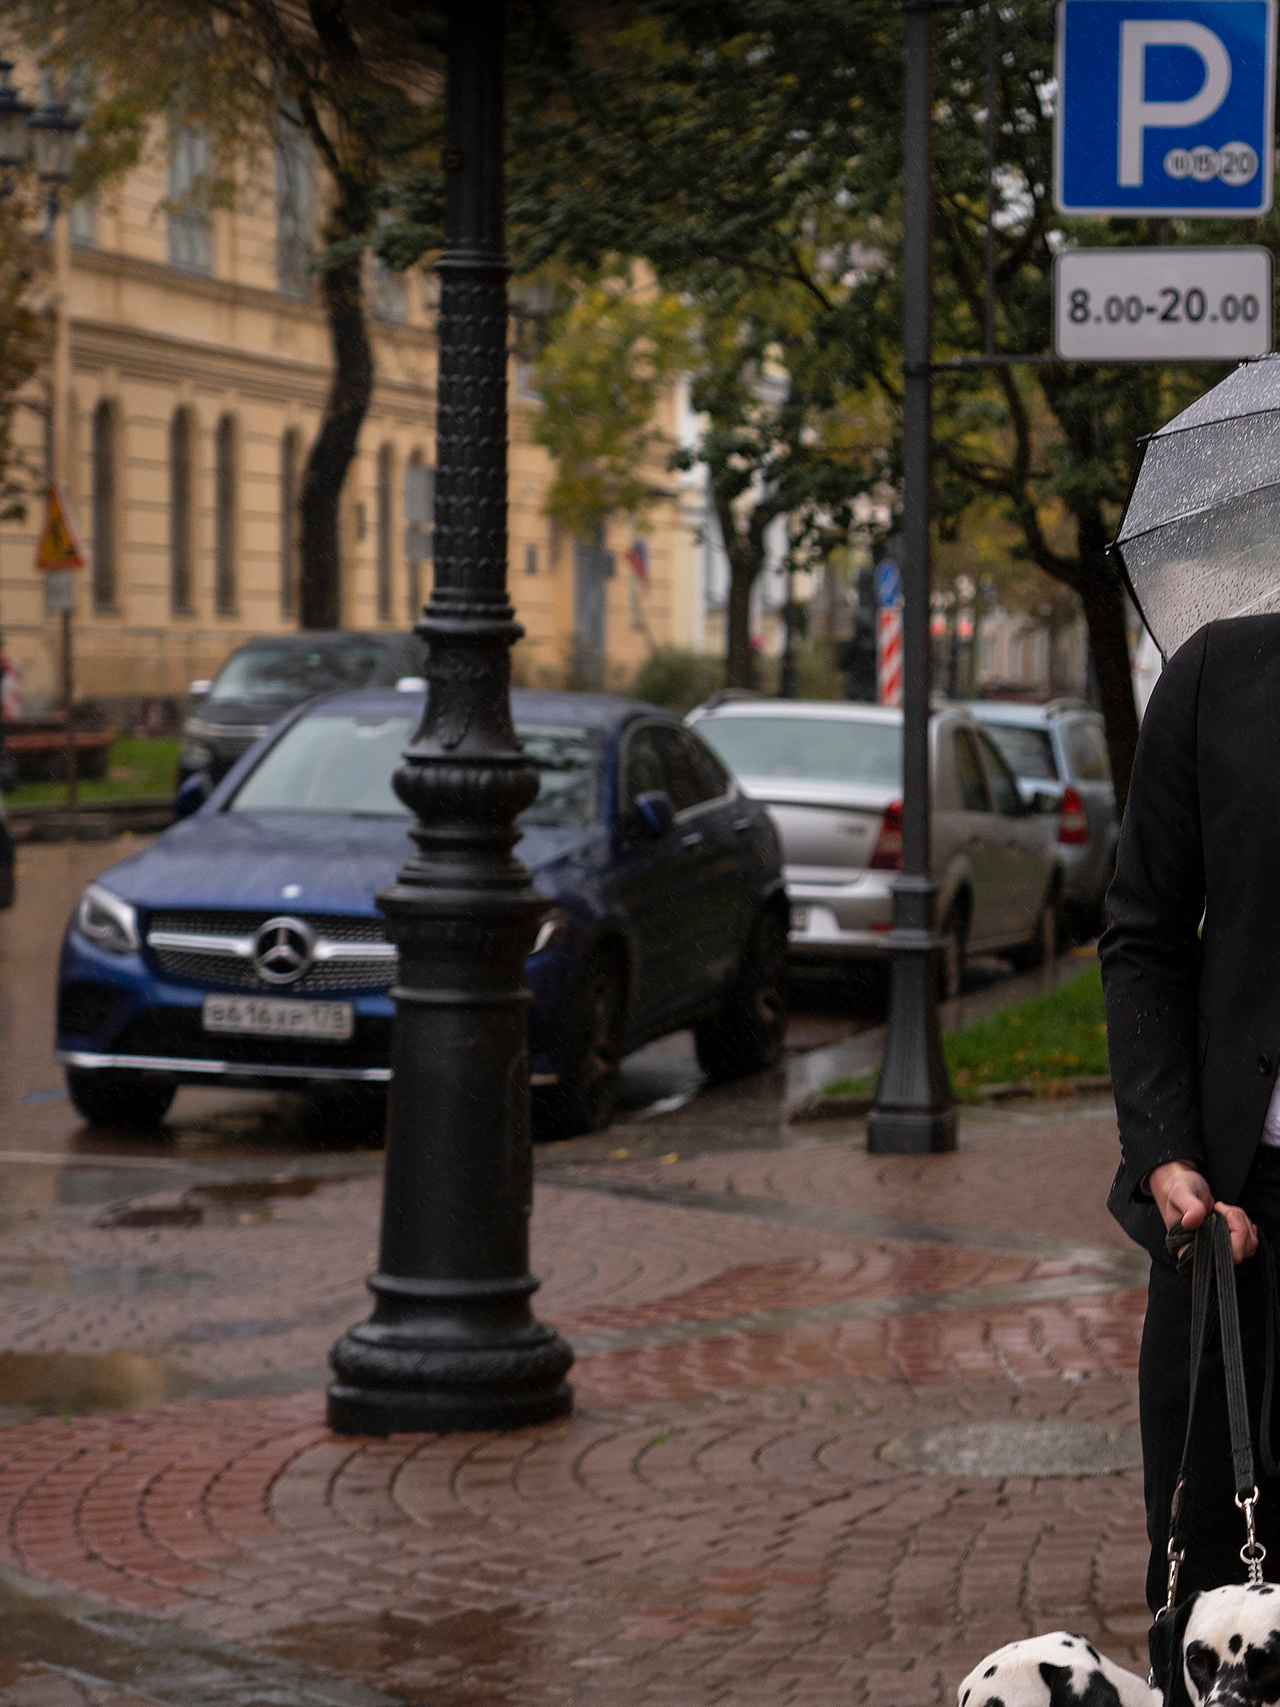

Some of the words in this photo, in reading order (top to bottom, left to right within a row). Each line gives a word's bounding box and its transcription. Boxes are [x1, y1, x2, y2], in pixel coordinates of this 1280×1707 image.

[1117, 19, 1232, 188] P
[1223, 151, 1256, 175] 20
[1069, 287, 1260, 324] 8.00-20.00
